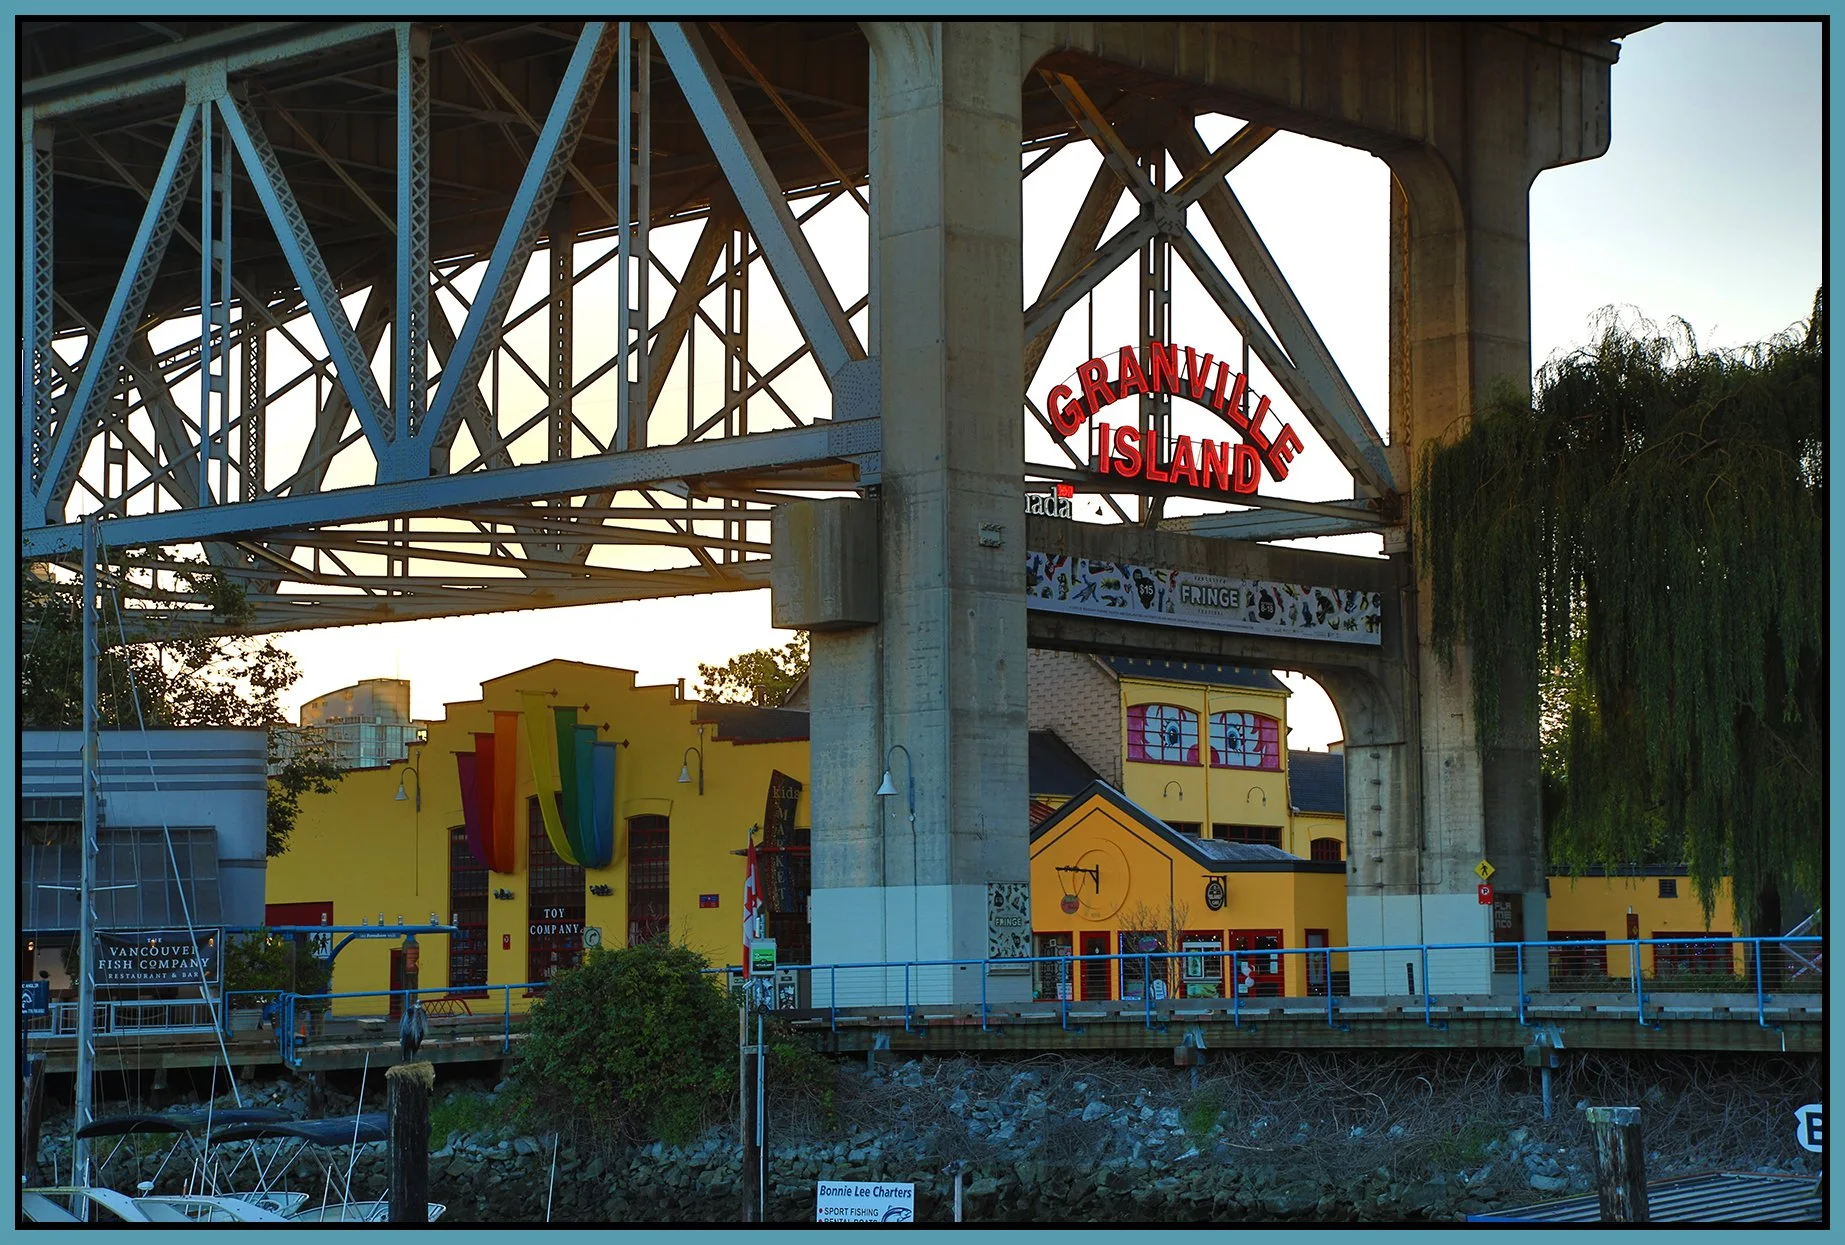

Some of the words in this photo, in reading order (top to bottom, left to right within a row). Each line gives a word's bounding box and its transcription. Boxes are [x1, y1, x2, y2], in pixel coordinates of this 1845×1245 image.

[1047, 341, 1304, 481] GRANVILLE
[1099, 422, 1262, 494] ISLAND
[1139, 584, 1154, 596] $15
[1181, 584, 1239, 608] FRINGE
[772, 786, 800, 799] kids
[544, 908, 565, 918] TOY
[995, 918, 1021, 927] FRINGE
[530, 924, 579, 934] COMPANY
[98, 959, 132, 970] FISH
[140, 958, 209, 970] COMPANY
[820, 1185, 852, 1197] Bonnie
[854, 1185, 870, 1197] Lee
[873, 1186, 912, 1198] Charters
[824, 1207, 848, 1216] SPORT
[850, 1208, 879, 1217] FISHING
